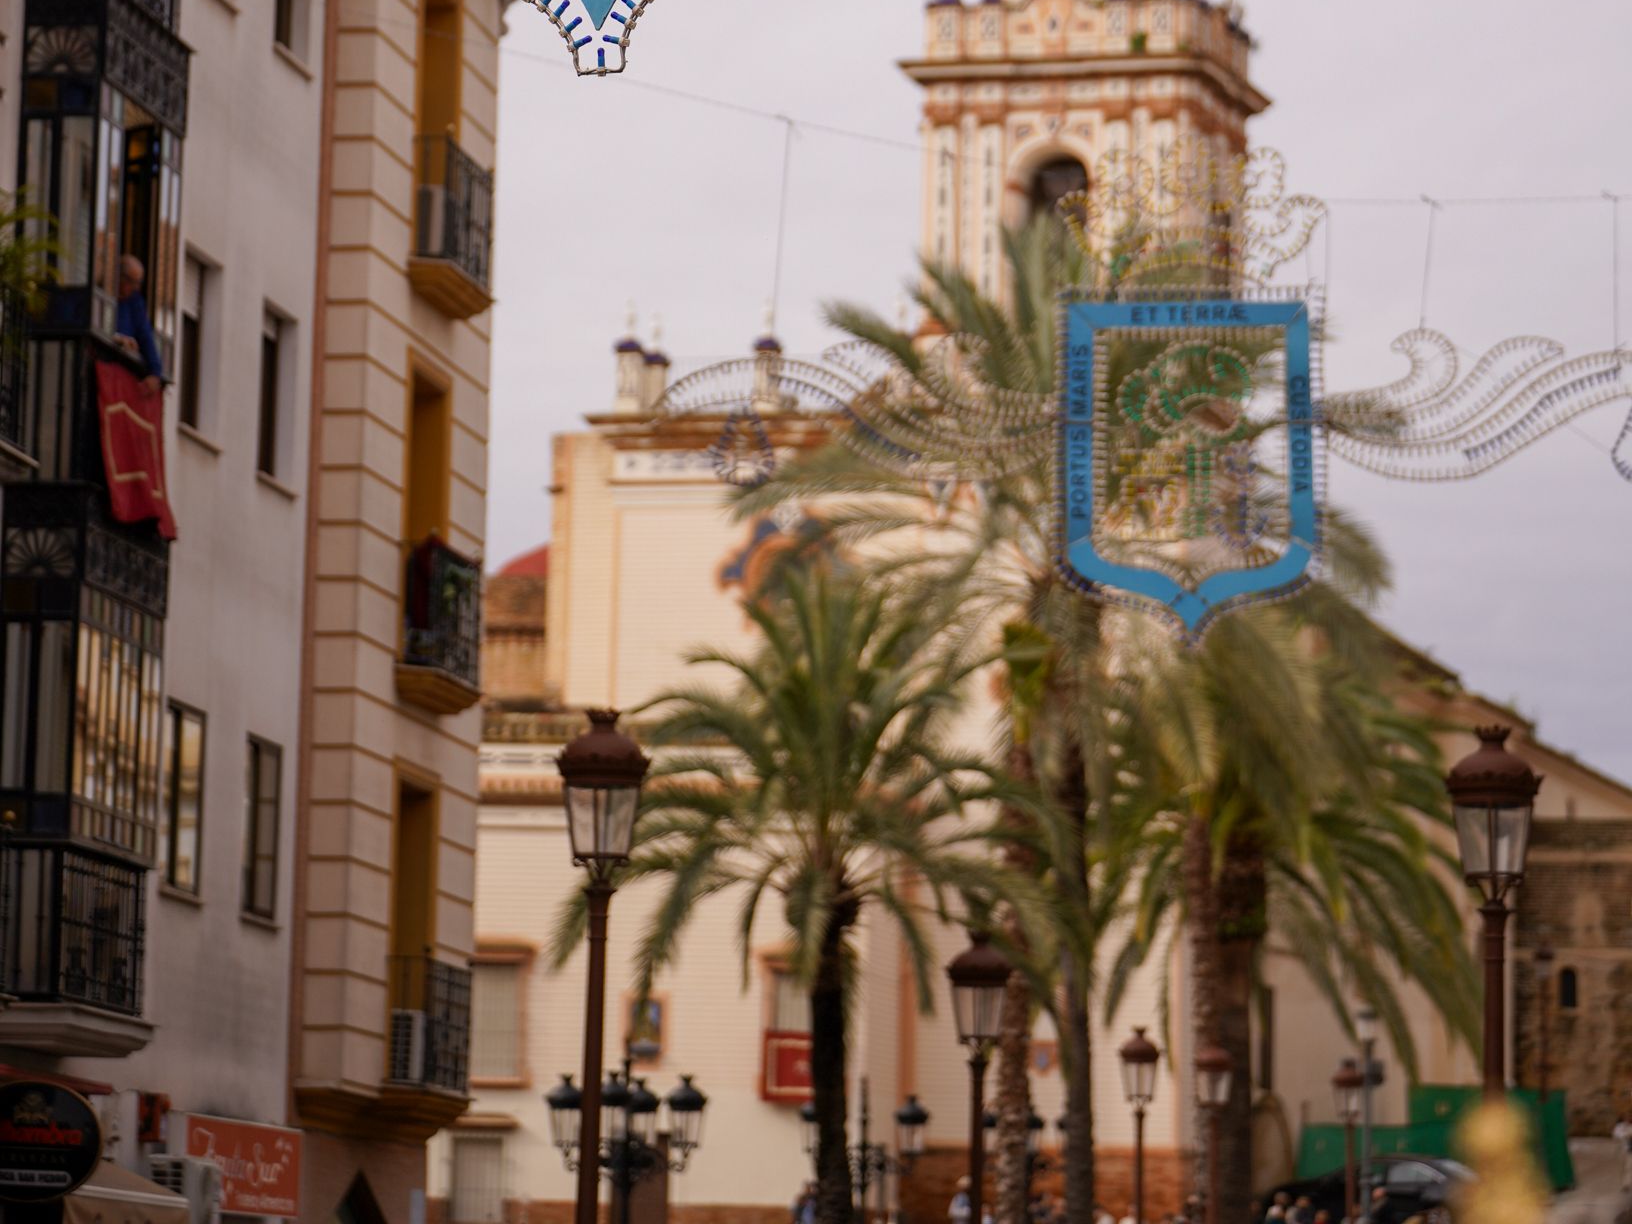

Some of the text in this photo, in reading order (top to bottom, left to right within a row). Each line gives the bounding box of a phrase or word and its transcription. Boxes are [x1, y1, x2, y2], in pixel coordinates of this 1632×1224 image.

[1130, 305, 1158, 324] ET
[1071, 343, 1089, 520] PORTUS MARIS
